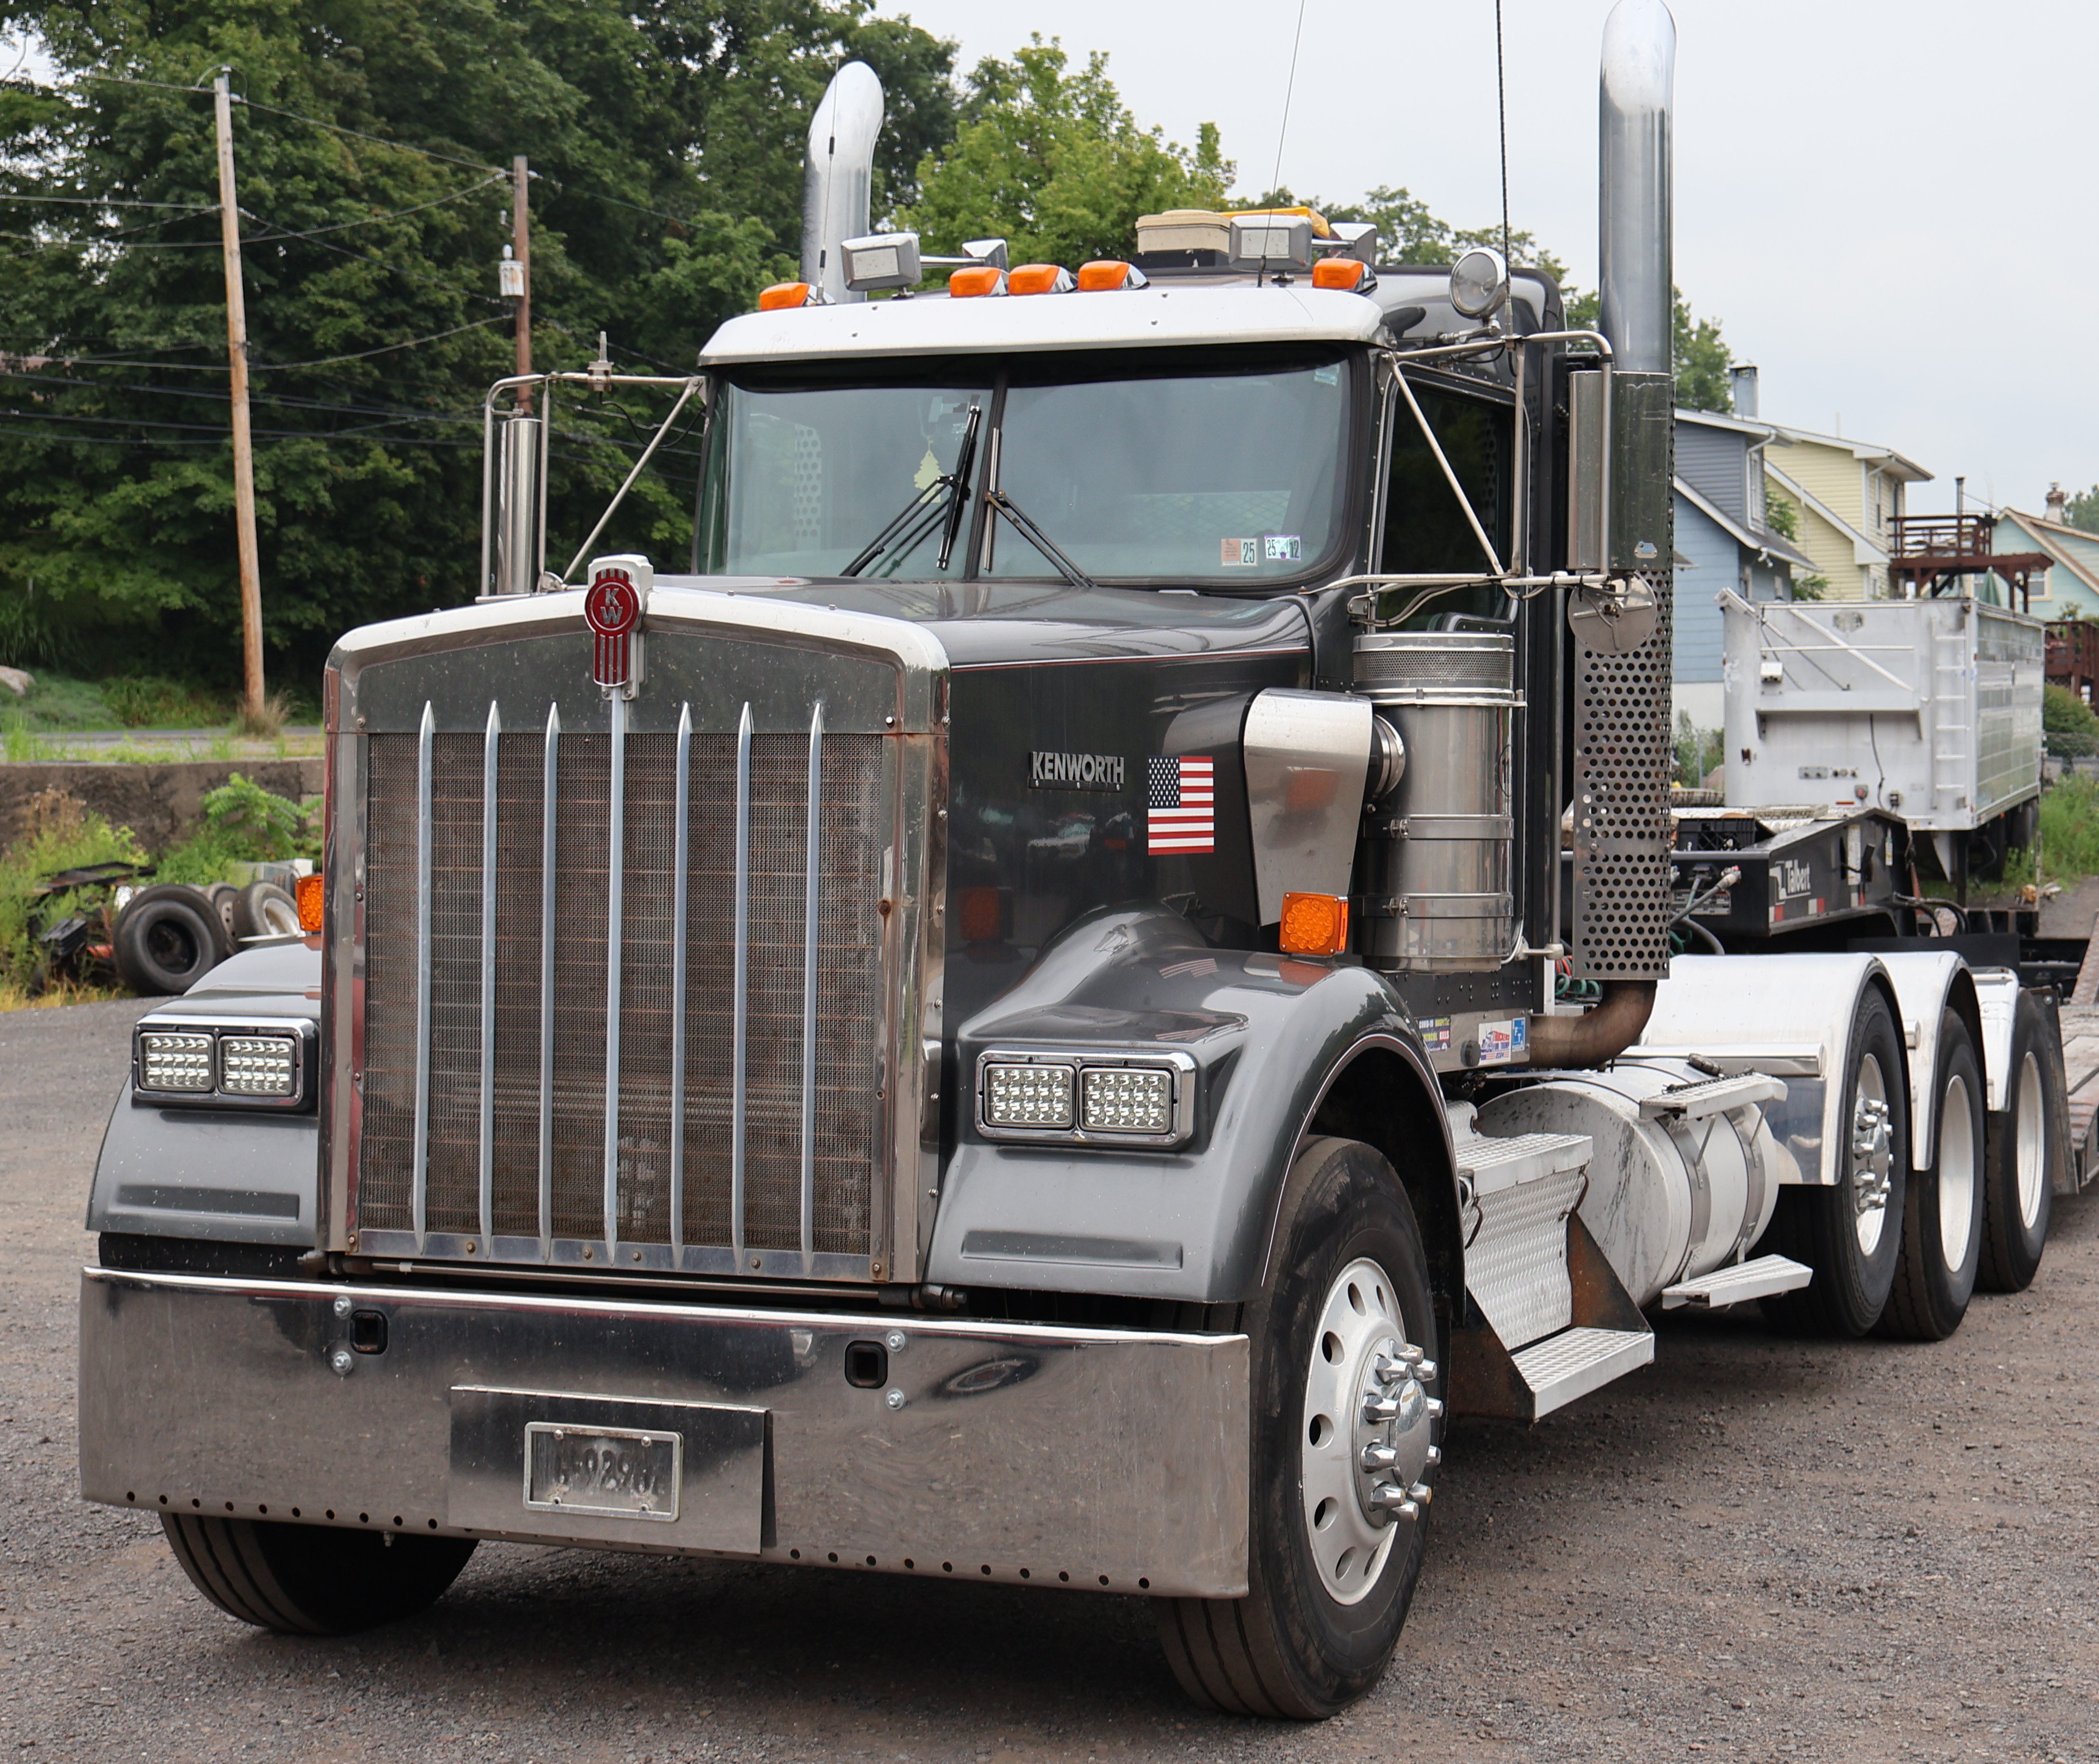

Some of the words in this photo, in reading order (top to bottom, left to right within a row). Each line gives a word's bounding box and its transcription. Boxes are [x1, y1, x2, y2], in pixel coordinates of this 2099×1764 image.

[1243, 542, 1255, 563] 25
[1267, 540, 1276, 556] 25
[1289, 541, 1300, 558] 12
[1032, 751, 1124, 784] KENWORTH
[1785, 859, 1811, 894] Talbert
[1439, 1030, 1449, 1041] KILLS
